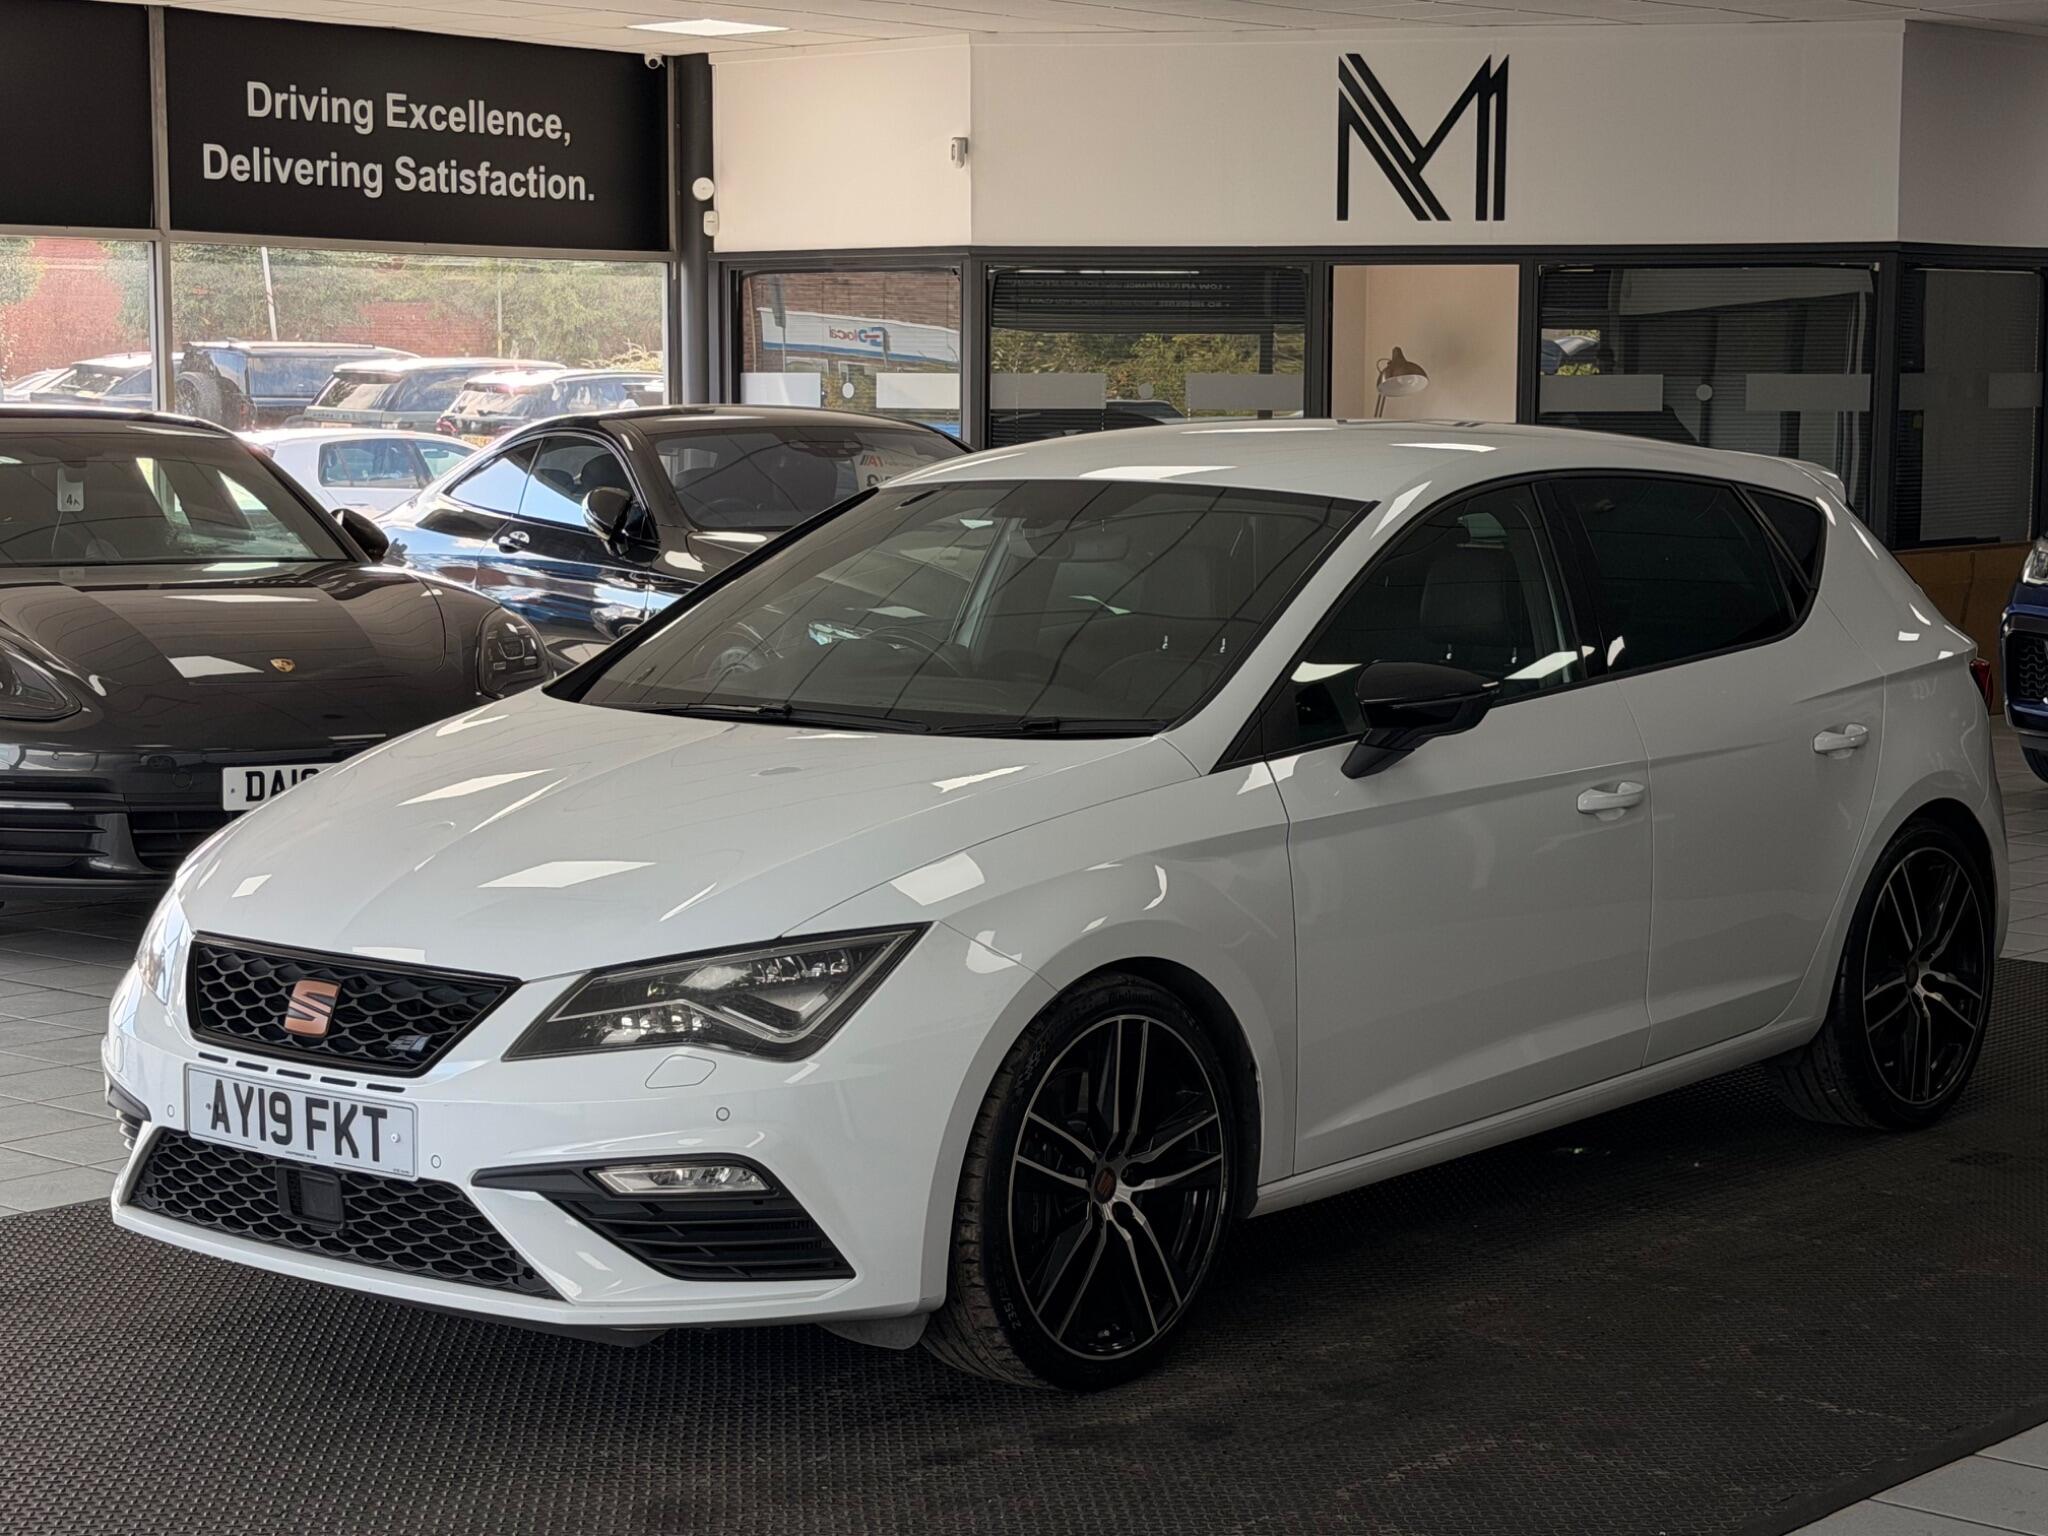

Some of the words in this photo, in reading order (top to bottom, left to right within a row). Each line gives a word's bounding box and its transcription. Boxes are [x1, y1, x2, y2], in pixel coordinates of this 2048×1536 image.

[247, 81, 374, 135] Driving
[386, 92, 571, 146] Excellence,
[203, 143, 383, 199] Delivering
[395, 156, 595, 201] Satisfaction.
[210, 1079, 293, 1146] AY19
[305, 1096, 388, 1162] FKT
